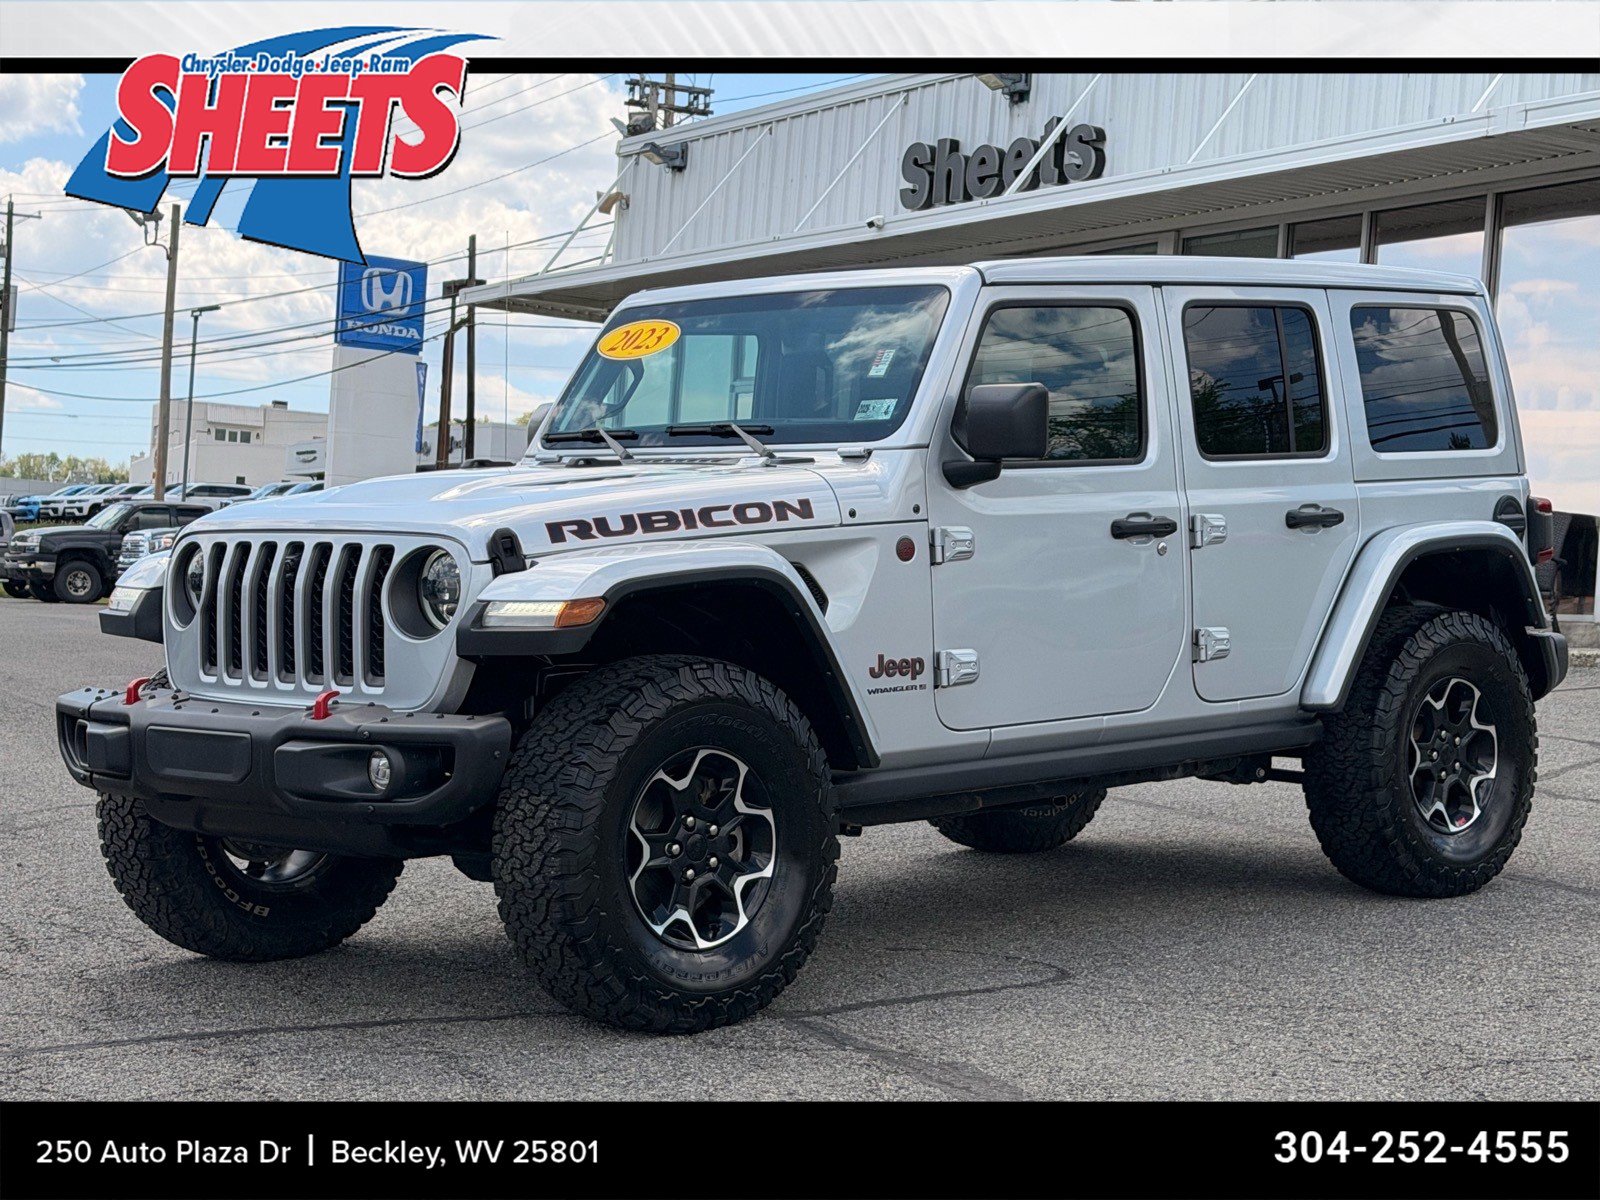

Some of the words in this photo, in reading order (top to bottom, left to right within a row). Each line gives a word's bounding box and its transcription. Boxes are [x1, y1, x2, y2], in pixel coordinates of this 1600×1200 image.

[900, 116, 1107, 209] Sheets
[345, 320, 421, 340] HONDA
[606, 326, 671, 352] 2023
[545, 498, 814, 543] RUBICON
[868, 653, 925, 681] Jeep
[866, 685, 918, 696] WRANGLER
